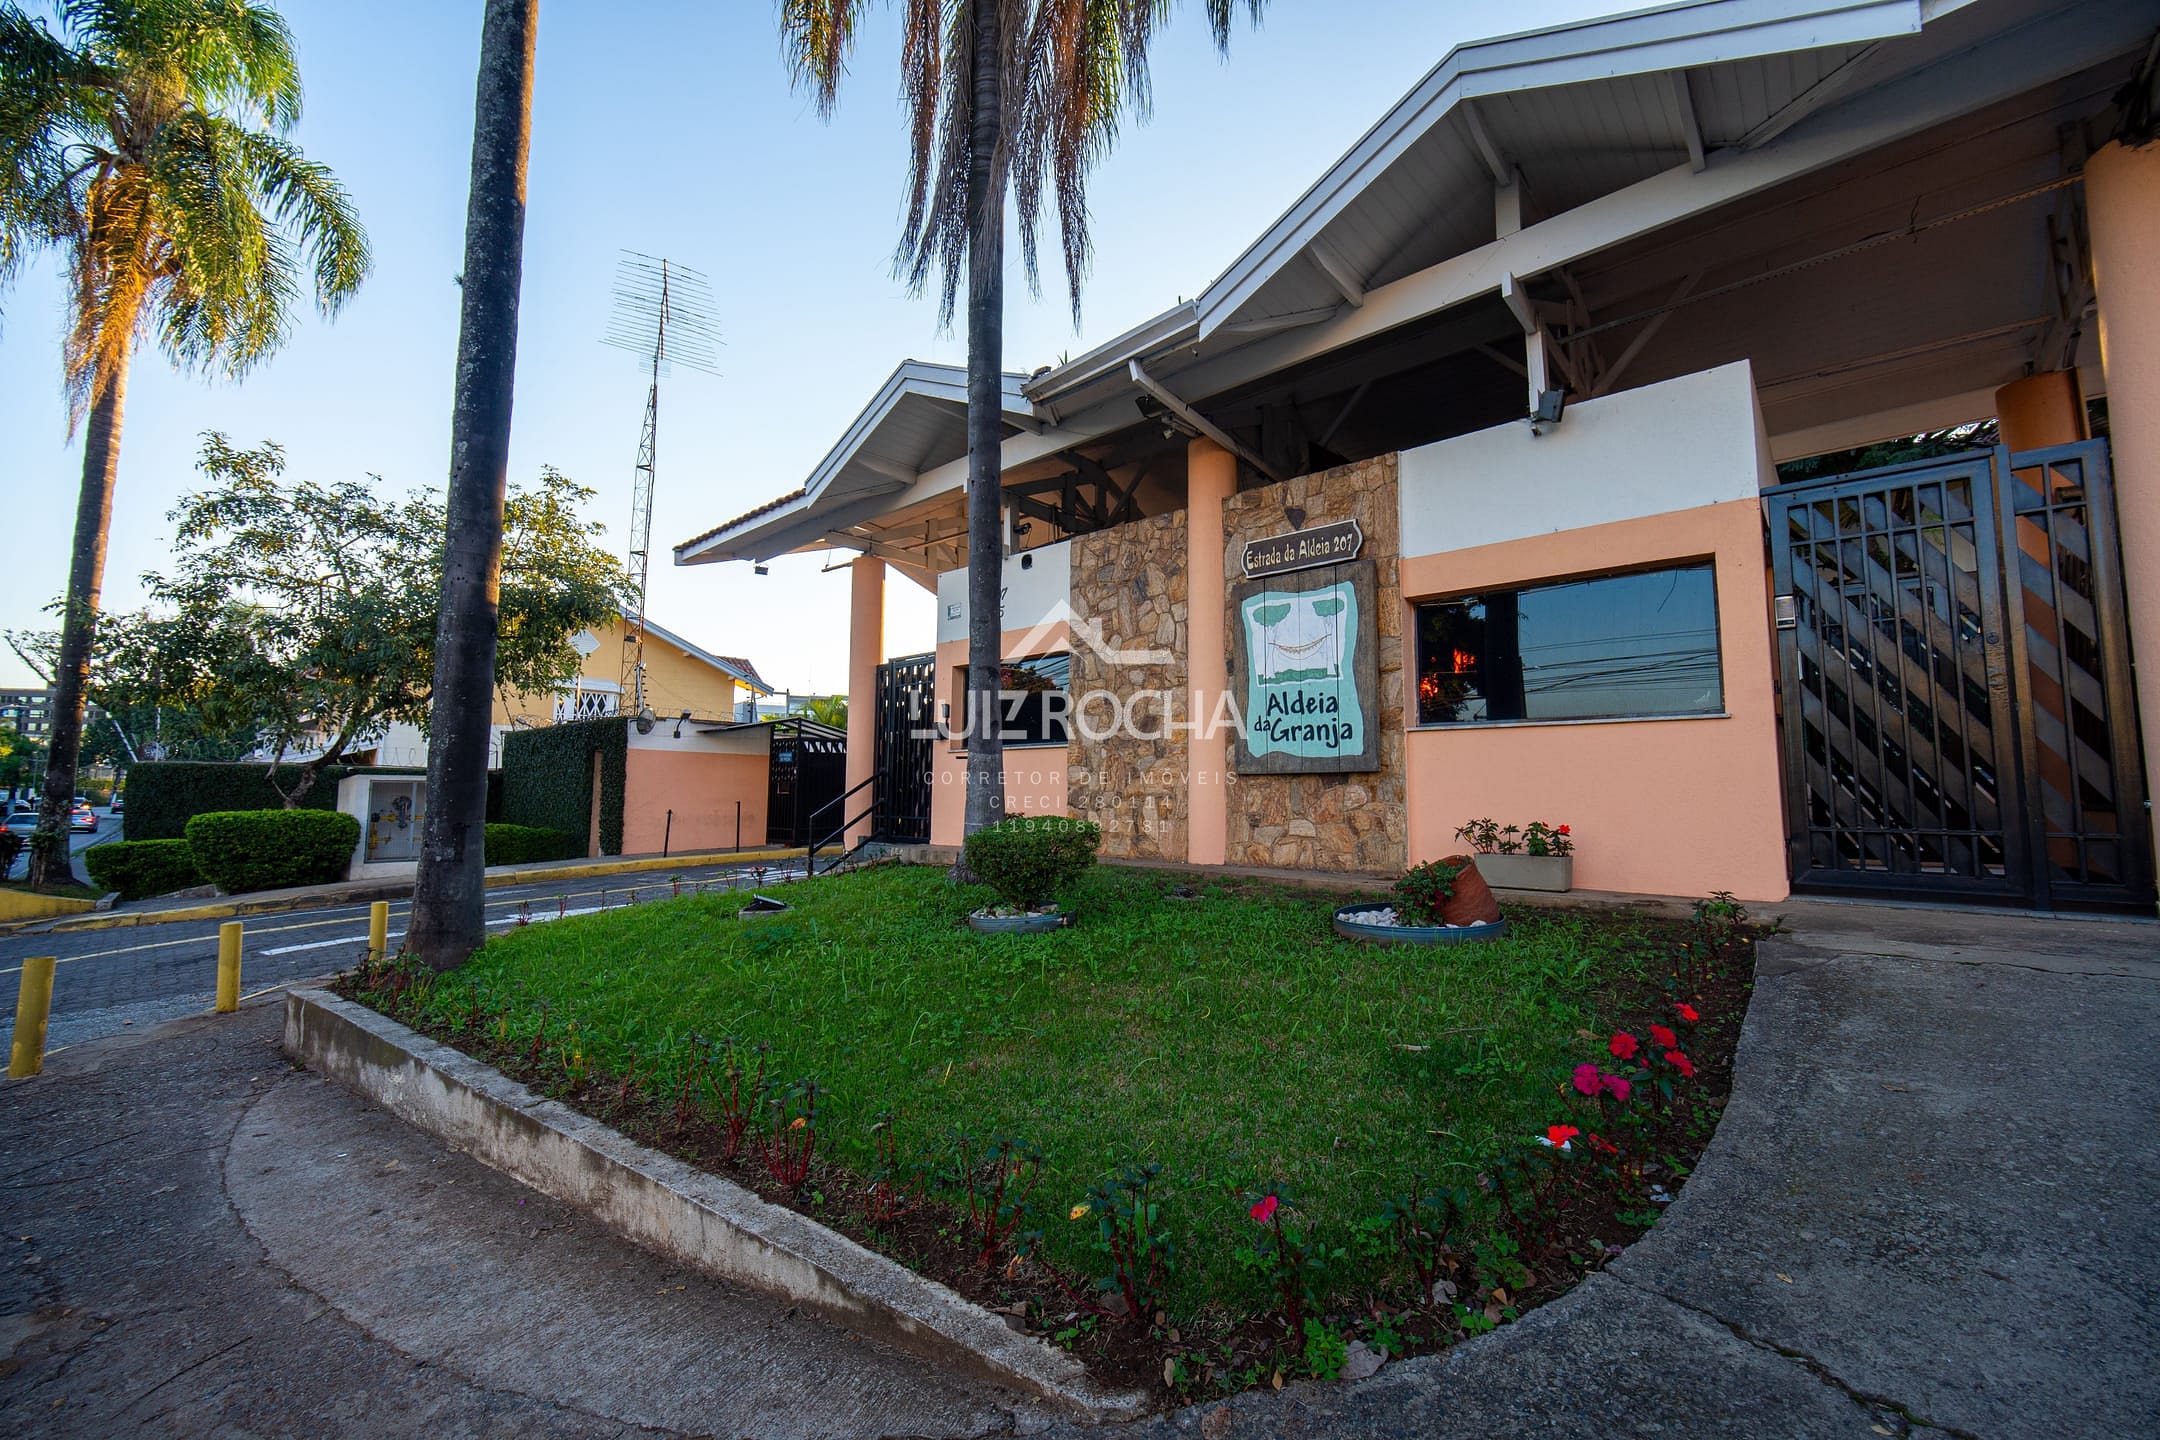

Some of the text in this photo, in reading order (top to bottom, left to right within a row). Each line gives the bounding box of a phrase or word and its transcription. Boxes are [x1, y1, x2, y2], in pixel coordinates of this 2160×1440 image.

[1246, 533, 1353, 569] Estrada da Aldeia 207
[1267, 690, 1338, 716] Aldeia
[1254, 715, 1353, 748] da Granja
